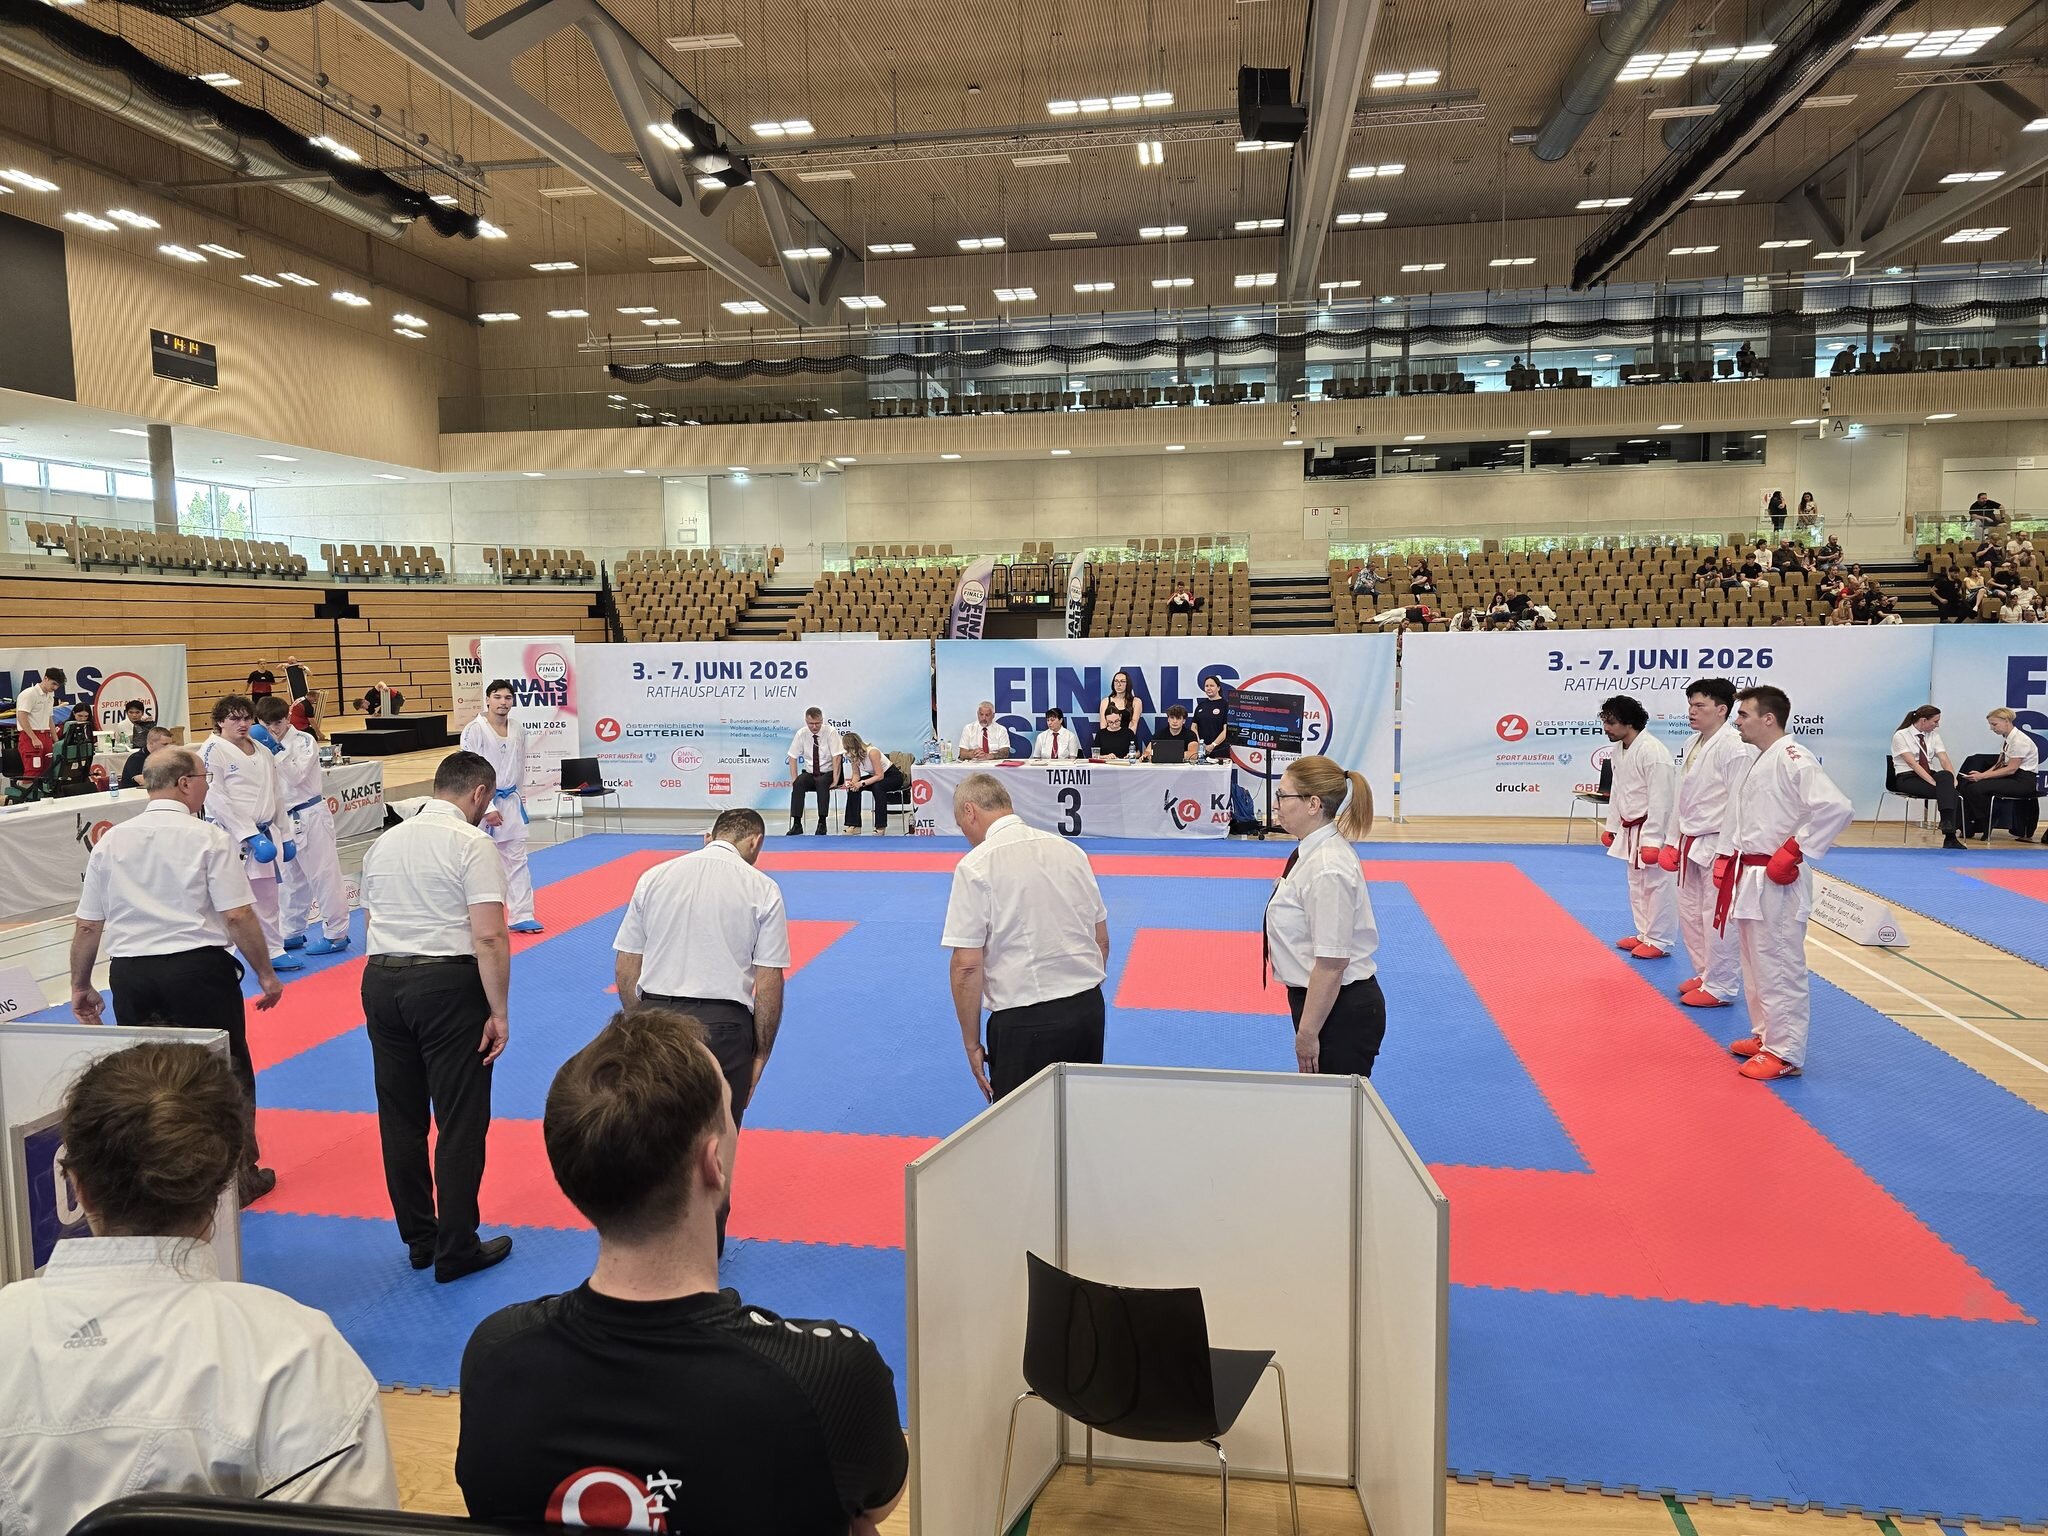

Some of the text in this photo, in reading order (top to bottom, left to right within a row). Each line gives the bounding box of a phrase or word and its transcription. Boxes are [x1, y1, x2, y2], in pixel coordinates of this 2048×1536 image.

[174, 337, 199, 355] 14:14
[1834, 420, 1843, 431] A
[803, 467, 810, 477] K
[1548, 651, 1572, 671] 3.
[1598, 651, 1619, 671] 7.
[1626, 649, 1688, 674] JUNI
[1697, 648, 1773, 669] 2026
[632, 662, 652, 680] 3.
[671, 662, 688, 680] 7.
[695, 661, 742, 683] JUNI
[749, 661, 808, 680] 2026
[1564, 676, 1691, 691] RATHAUSPLATZ
[647, 686, 745, 698] RATHAUSPLATZ
[764, 685, 797, 698] WIEN
[544, 721, 566, 729] 2026
[827, 719, 851, 727] Stadt
[1793, 714, 1824, 724] Stadt
[1536, 728, 1603, 736] LOTTER
[1793, 726, 1824, 735] Wien
[1046, 769, 1091, 785] TATAMI
[341, 782, 381, 802] KARATE
[1496, 783, 1540, 792] druck.at
[1057, 787, 1082, 837] 3
